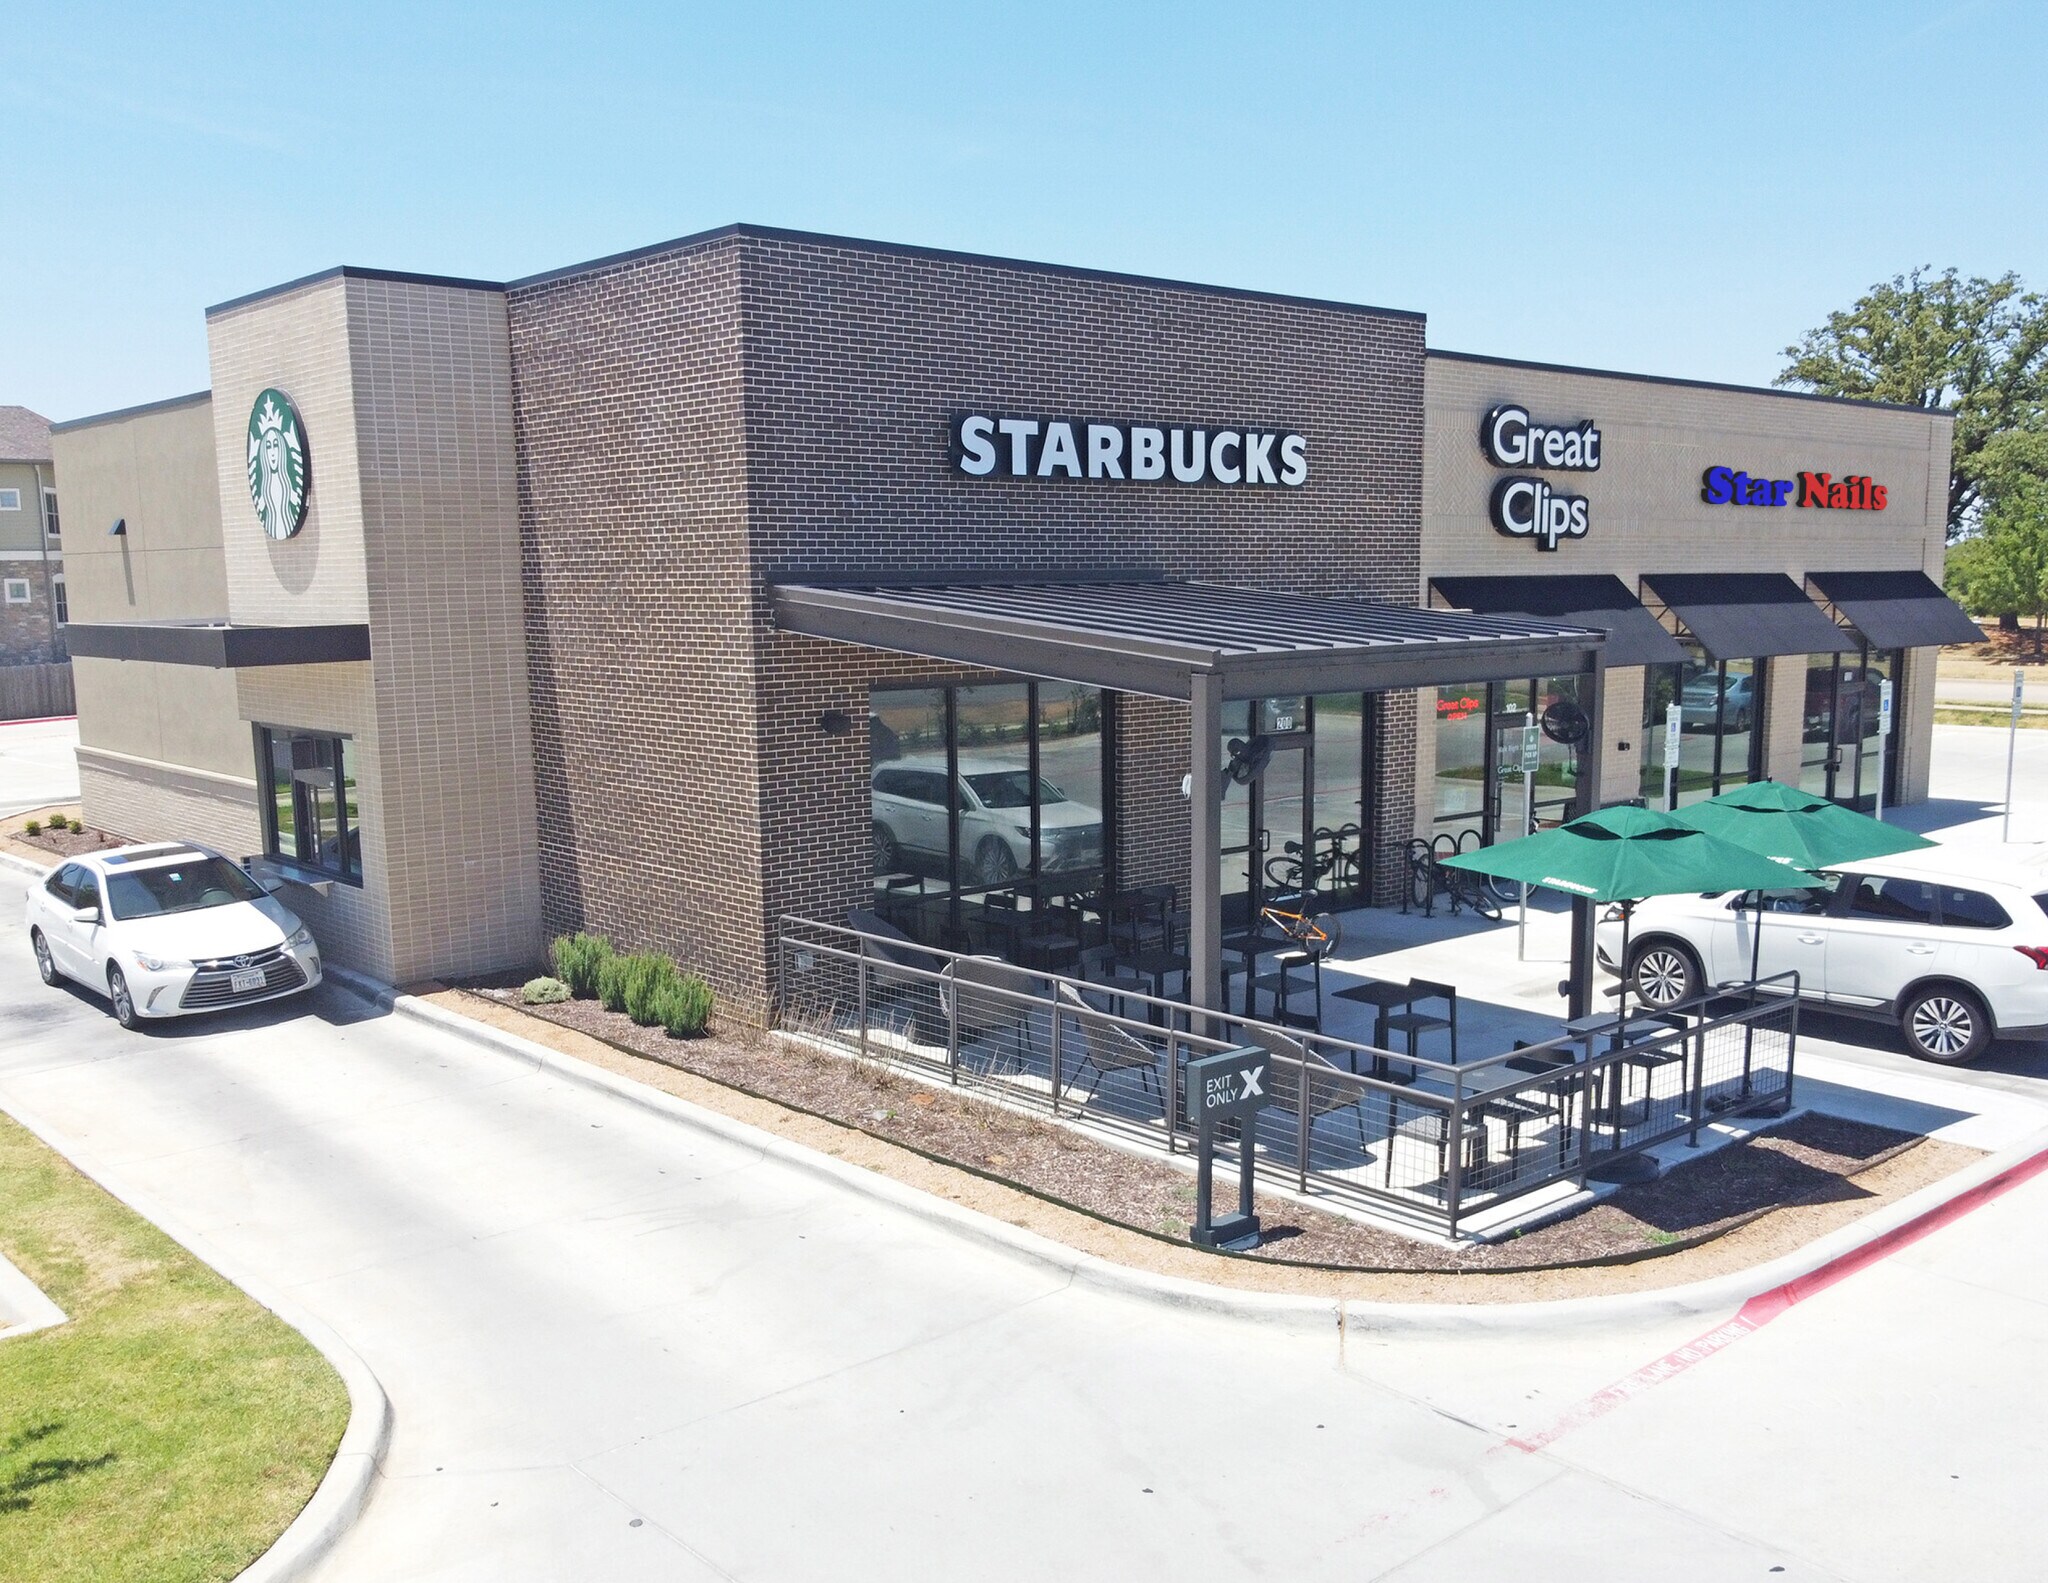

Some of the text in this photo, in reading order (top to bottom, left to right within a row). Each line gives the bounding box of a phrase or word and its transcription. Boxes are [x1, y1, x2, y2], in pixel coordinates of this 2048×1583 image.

[960, 415, 1308, 487] STARBUCKS
[1492, 408, 1599, 469] Great
[1706, 465, 1889, 511] Star Nails
[1502, 481, 1588, 549] Clips
[1436, 697, 1480, 711] Great Clips
[1506, 703, 1517, 713] 102
[1206, 1074, 1232, 1093] EXIT
[1206, 1088, 1238, 1108] ONLY
